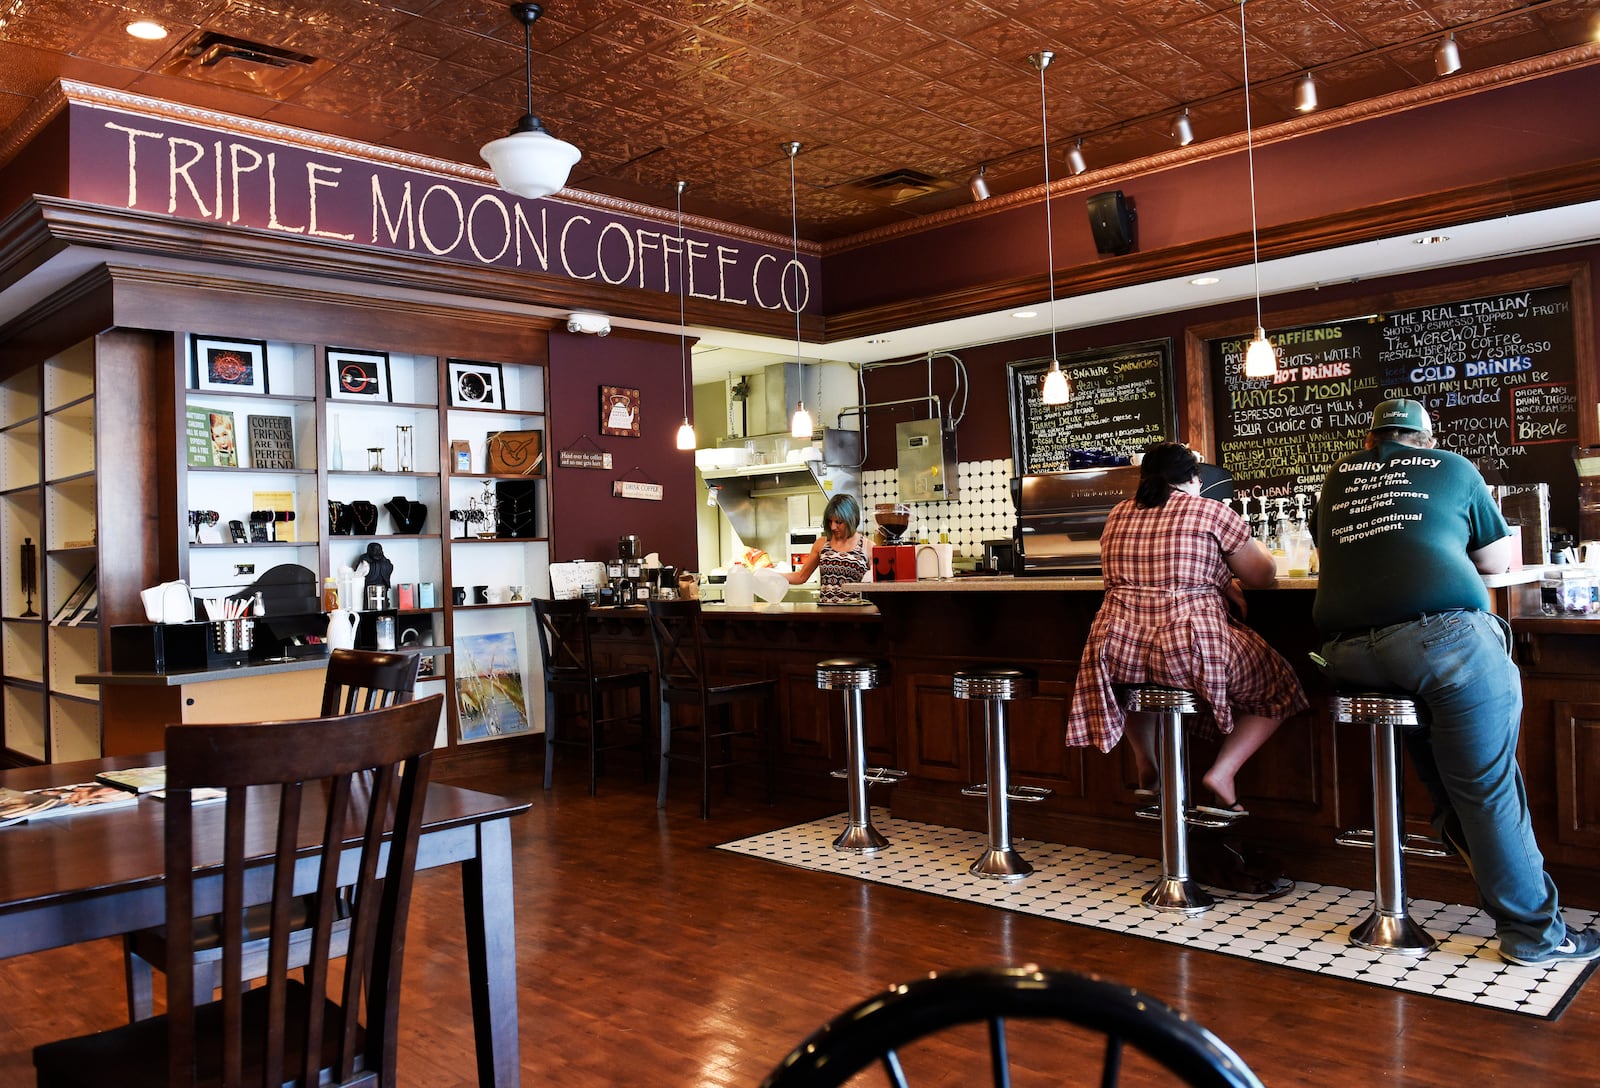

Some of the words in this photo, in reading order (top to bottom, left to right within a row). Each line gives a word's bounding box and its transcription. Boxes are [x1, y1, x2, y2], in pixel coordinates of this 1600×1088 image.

[105, 121, 355, 240] TRIPLE
[371, 174, 548, 271] MOON
[561, 215, 747, 304] COFFEE
[753, 253, 809, 313] CO
[1391, 312, 1419, 327] THE
[1422, 307, 1456, 321] REAL
[1383, 325, 1412, 337] SHOTS
[1221, 340, 1243, 354] FOR
[1279, 353, 1313, 368] SHOTS
[1273, 368, 1298, 384] HOT
[1410, 365, 1457, 383] COLD
[1439, 381, 1461, 393] ANY
[1503, 373, 1526, 385] CAN
[1232, 386, 1299, 409] HARVEST
[1305, 378, 1351, 401] MOON
[1446, 387, 1500, 408] Blended
[252, 417, 282, 429] COFFEE
[253, 429, 291, 441] FRIENDS
[254, 440, 273, 449] ARE
[275, 441, 291, 449] THE
[1488, 443, 1528, 456] MOCHA
[255, 450, 292, 461] PERFECT
[256, 460, 294, 470] BLEND
[1339, 461, 1385, 473] Quality
[1390, 456, 1442, 469] Policy
[1345, 486, 1359, 494] the
[1361, 482, 1382, 492] first
[1385, 478, 1412, 486] time.
[1354, 477, 1367, 485] Do
[1370, 475, 1378, 483] it
[1379, 471, 1406, 481] right
[1331, 501, 1350, 512] Keep
[1351, 498, 1368, 507] our
[1371, 490, 1430, 502] customers
[1349, 499, 1395, 515] satisfied.
[1332, 524, 1354, 537] Focus
[1356, 521, 1369, 530] on
[1371, 512, 1423, 526] continual
[1340, 522, 1405, 544] improvement.
